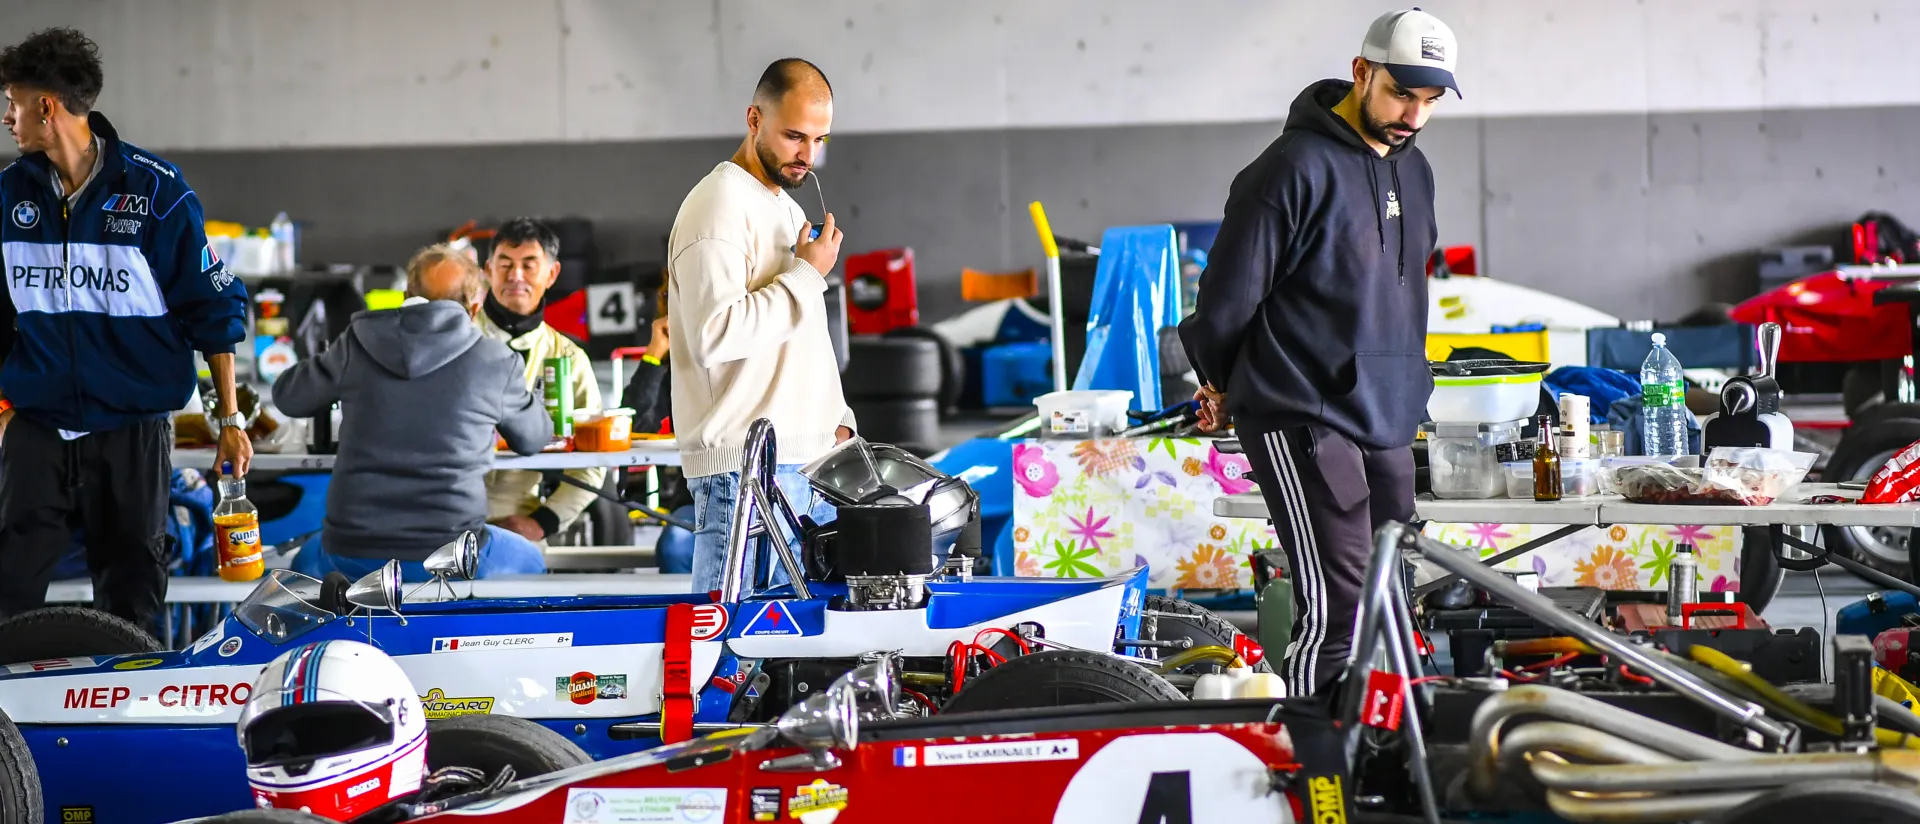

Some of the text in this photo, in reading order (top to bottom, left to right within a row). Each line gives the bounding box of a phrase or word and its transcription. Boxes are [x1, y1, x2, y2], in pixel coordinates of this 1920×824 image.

[104, 214, 142, 235] Power
[13, 265, 130, 292] PETRONAS
[600, 290, 627, 325] 4
[460, 639, 481, 648] Jean
[483, 638, 501, 647] Guy
[502, 637, 535, 646] CLERC
[567, 678, 598, 694] Classic
[64, 687, 130, 709] MEP
[572, 688, 594, 699] Festival
[422, 701, 490, 711] NOGARO
[1051, 745, 1068, 755] A+
[63, 810, 92, 821] OMP
